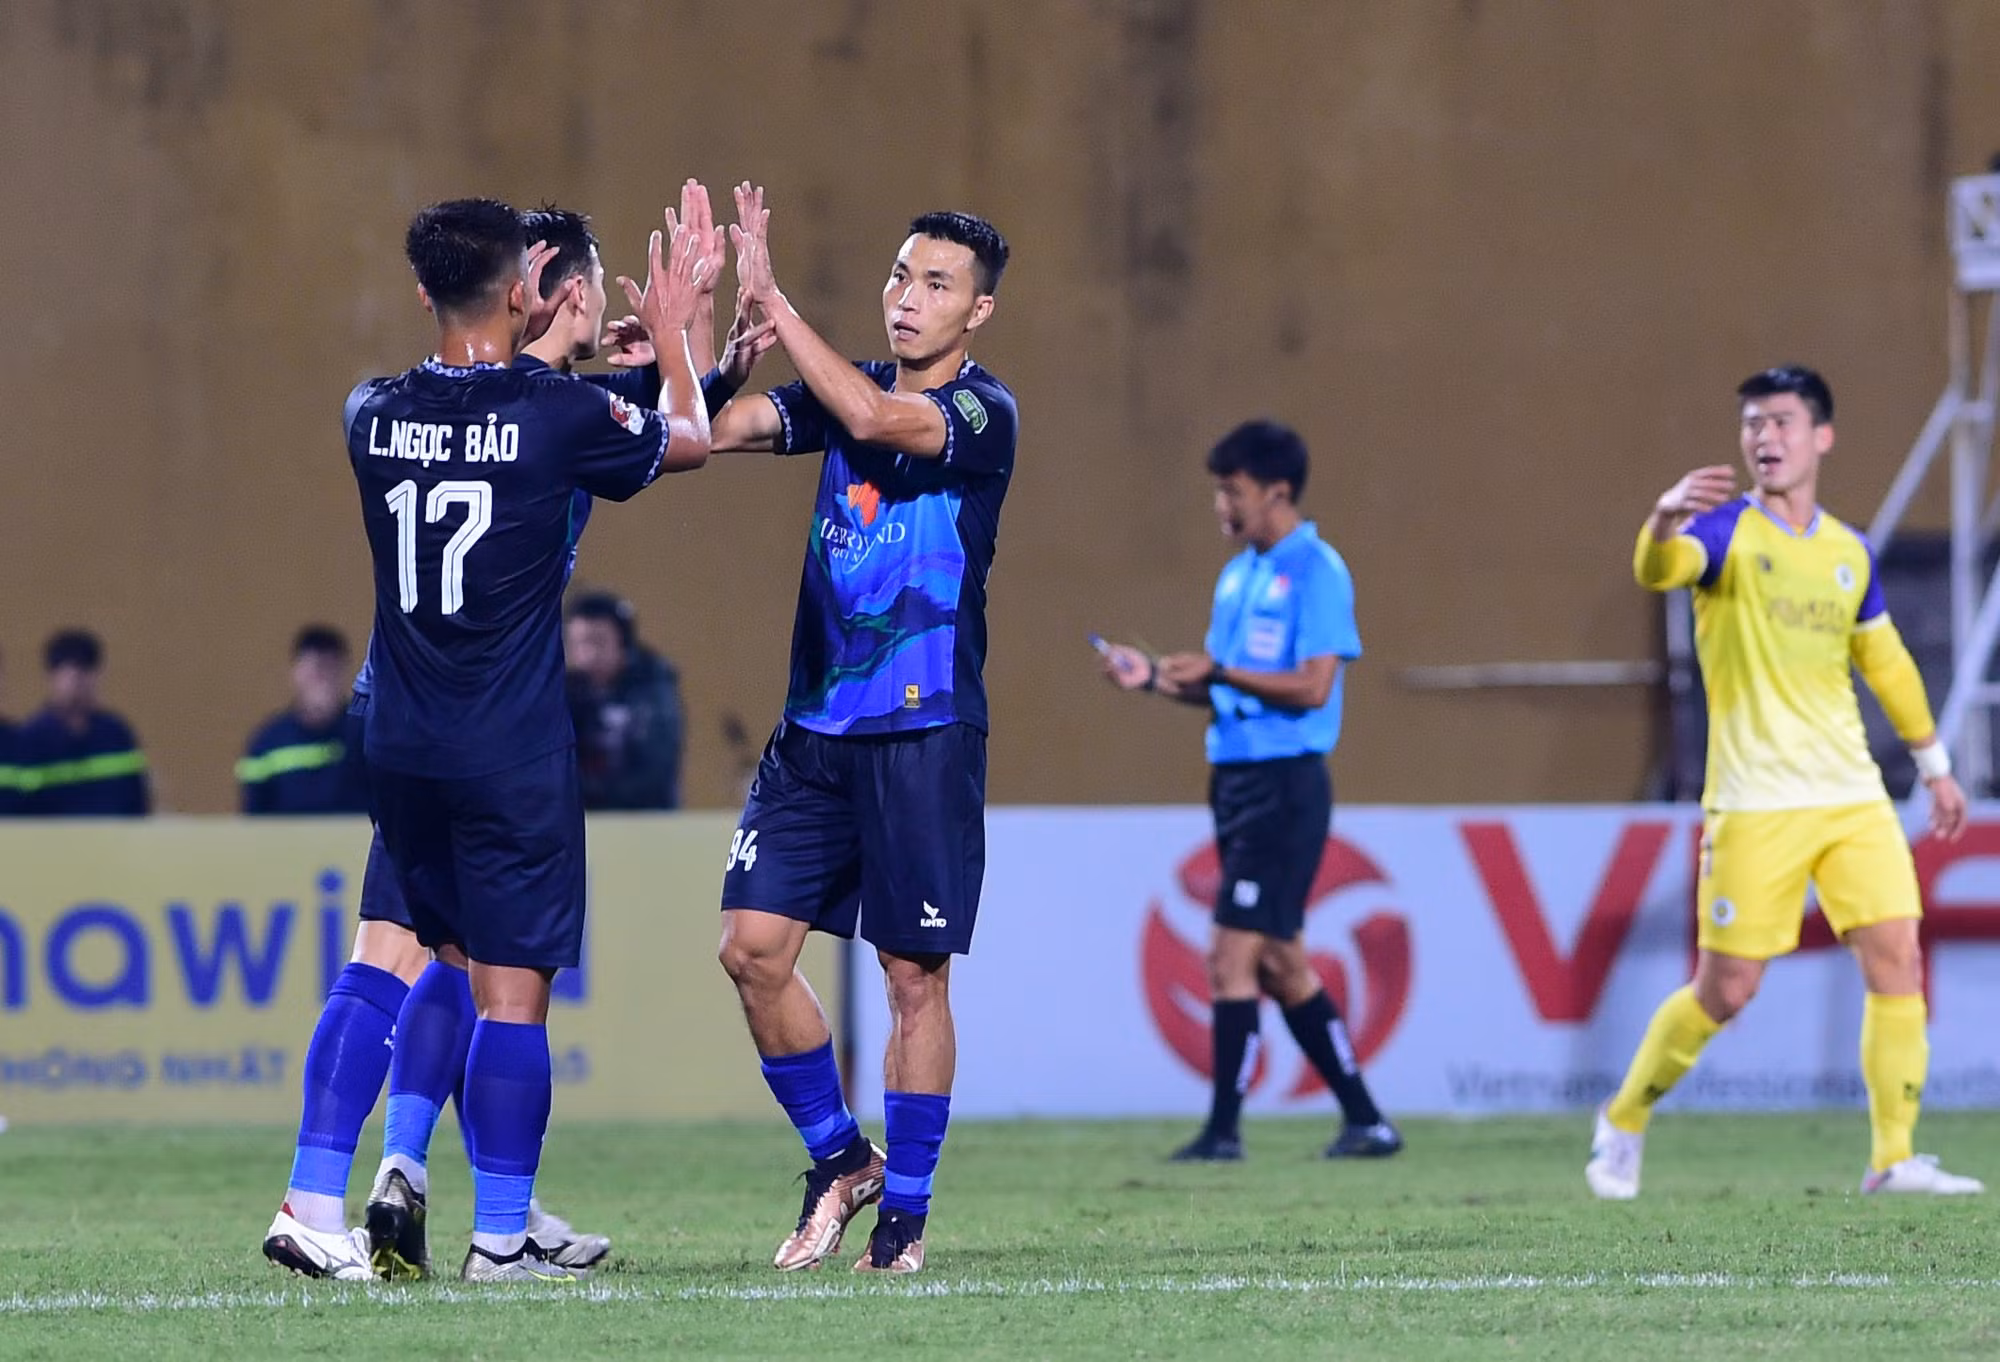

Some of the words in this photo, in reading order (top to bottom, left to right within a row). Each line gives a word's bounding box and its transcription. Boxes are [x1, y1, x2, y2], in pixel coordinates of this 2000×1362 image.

[369, 416, 453, 468] L.NGỌC
[465, 413, 520, 463] BẢO
[385, 479, 493, 615] 17
[726, 829, 759, 871] 94
[1458, 821, 2000, 1026] VF
